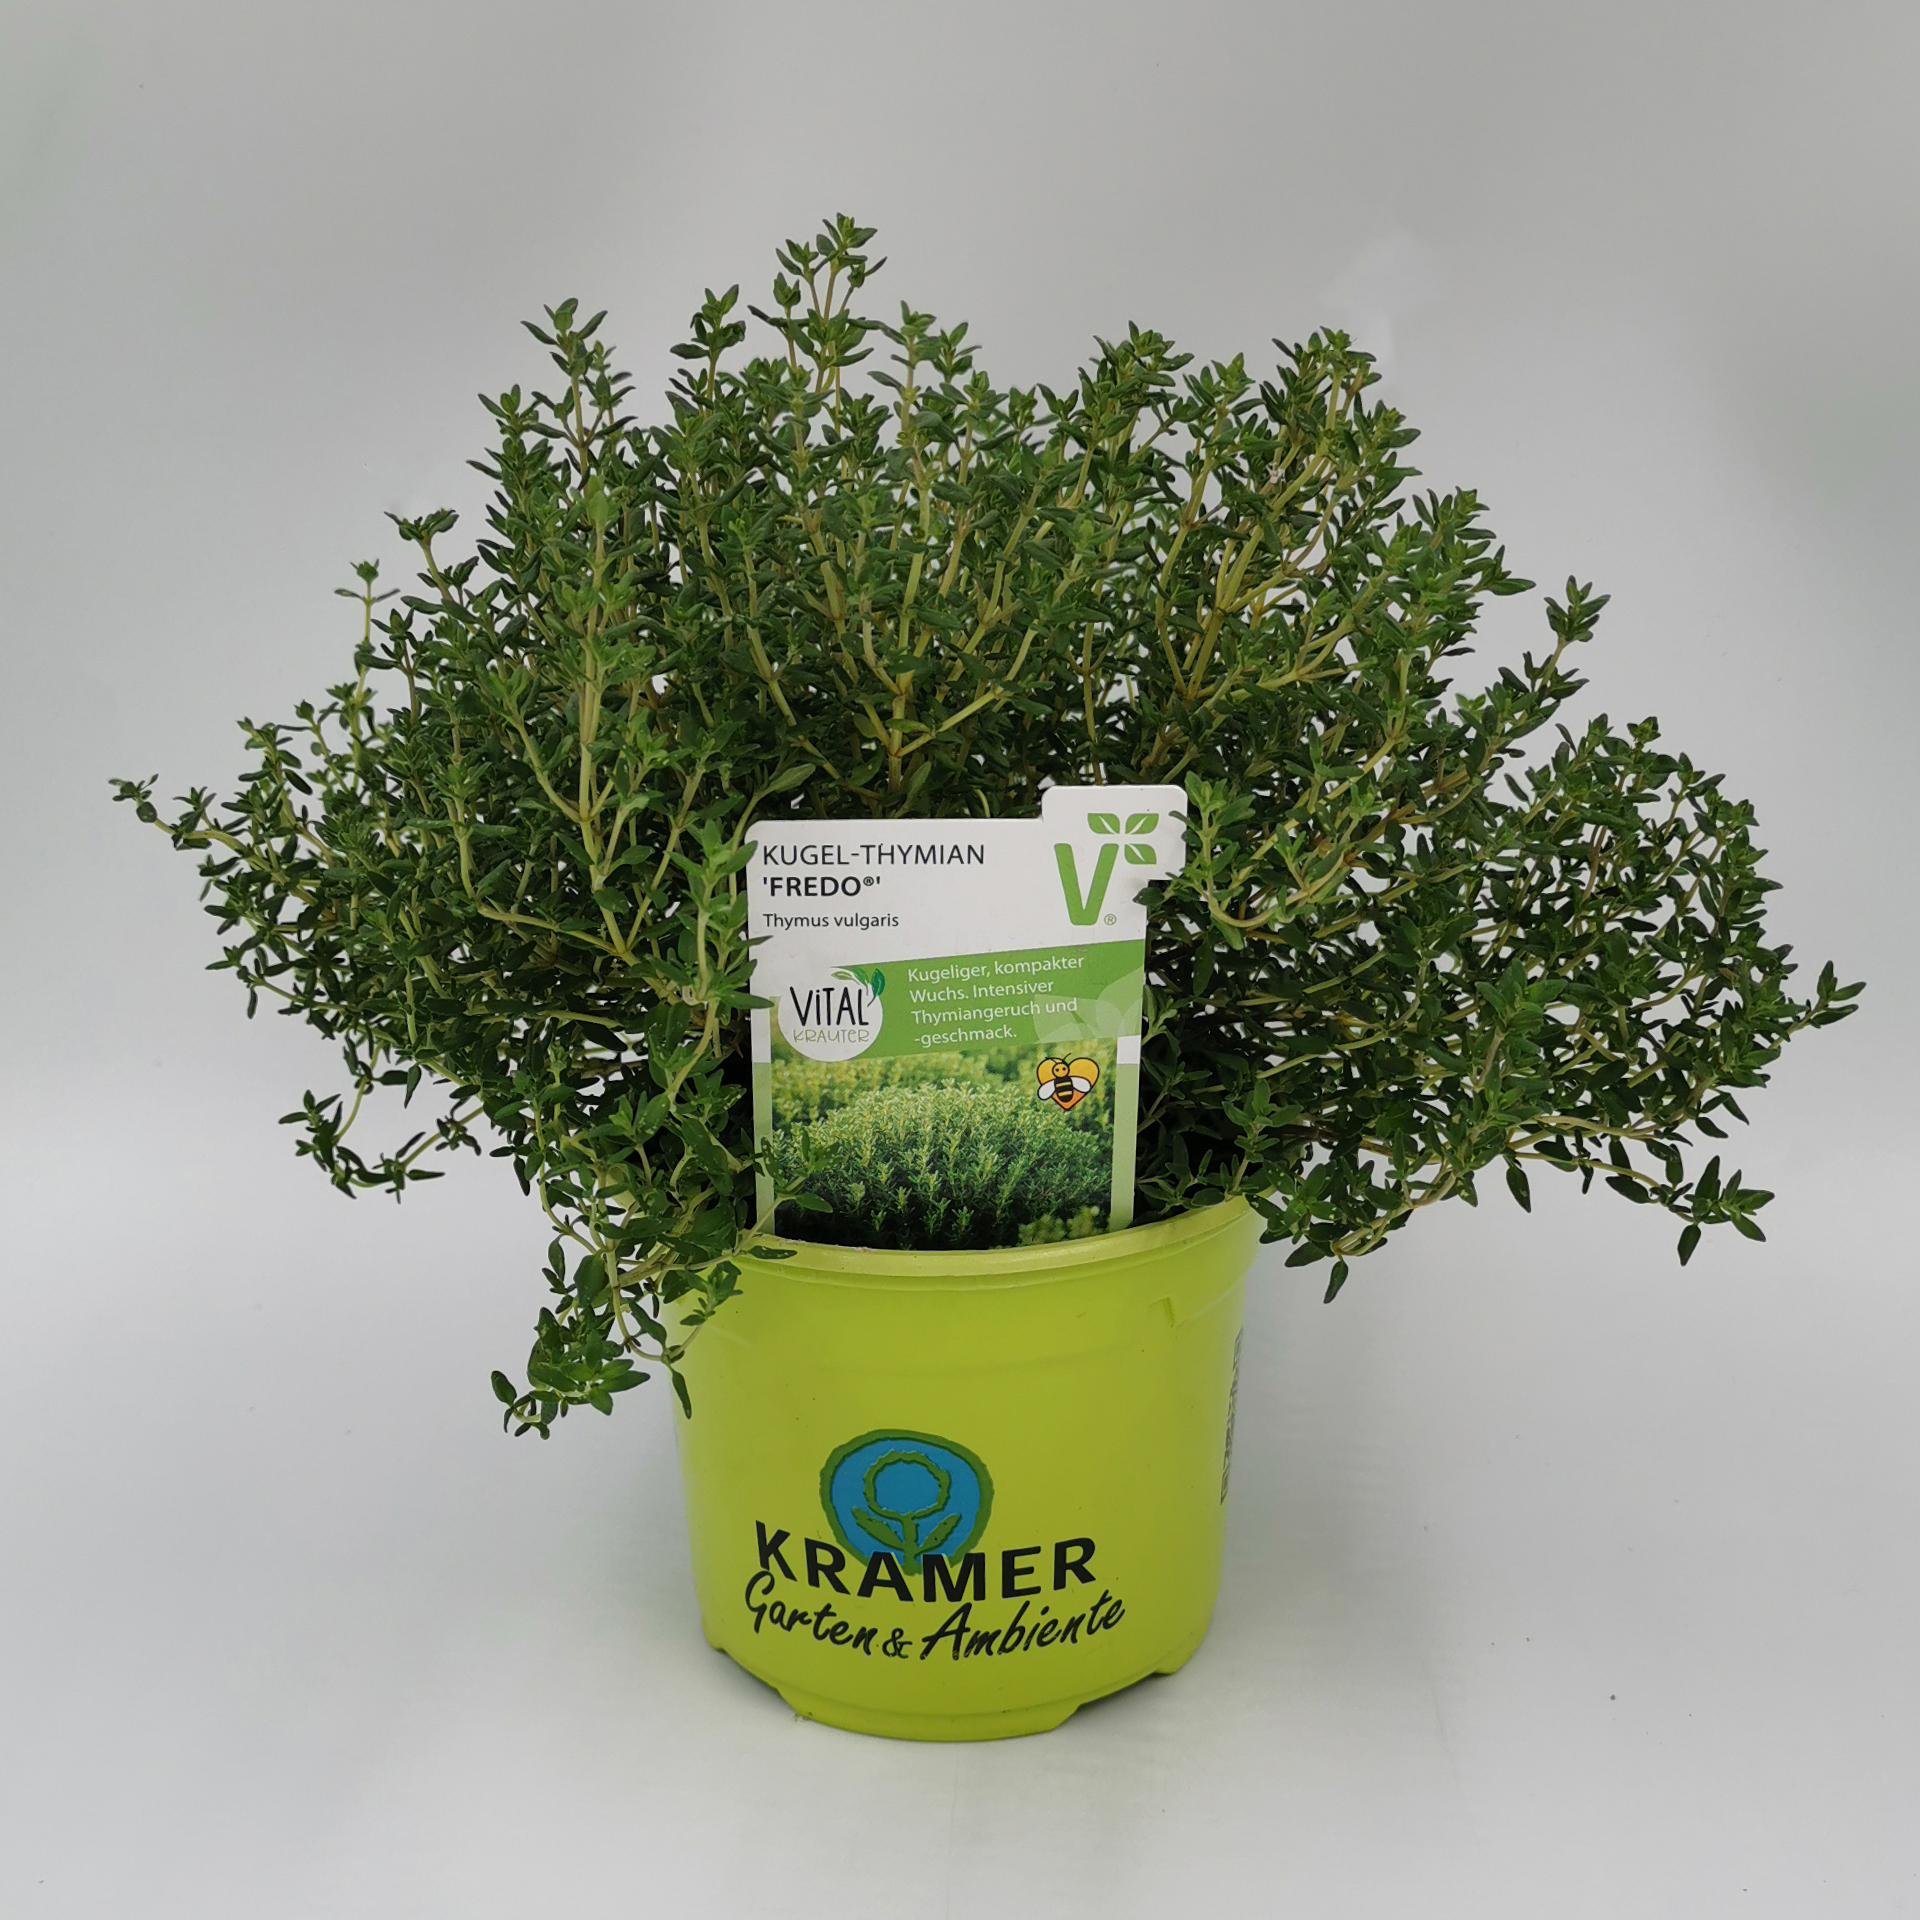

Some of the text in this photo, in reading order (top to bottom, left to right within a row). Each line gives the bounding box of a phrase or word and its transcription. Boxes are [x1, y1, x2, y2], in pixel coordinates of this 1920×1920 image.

[763, 843, 985, 866] KUGEL-THYMIAN
[763, 913, 899, 931] Thymus vulgaris
[907, 955, 1085, 984] Kugeliger, kompakter
[909, 980, 1054, 1003] Wuchs. Intensiver
[911, 996, 1078, 1027] Thymiangeruch und
[914, 1024, 1017, 1049] -geschmack.
[755, 1519, 1097, 1604] KRAMER
[744, 1569, 1126, 1662] Garten & Ambiente
